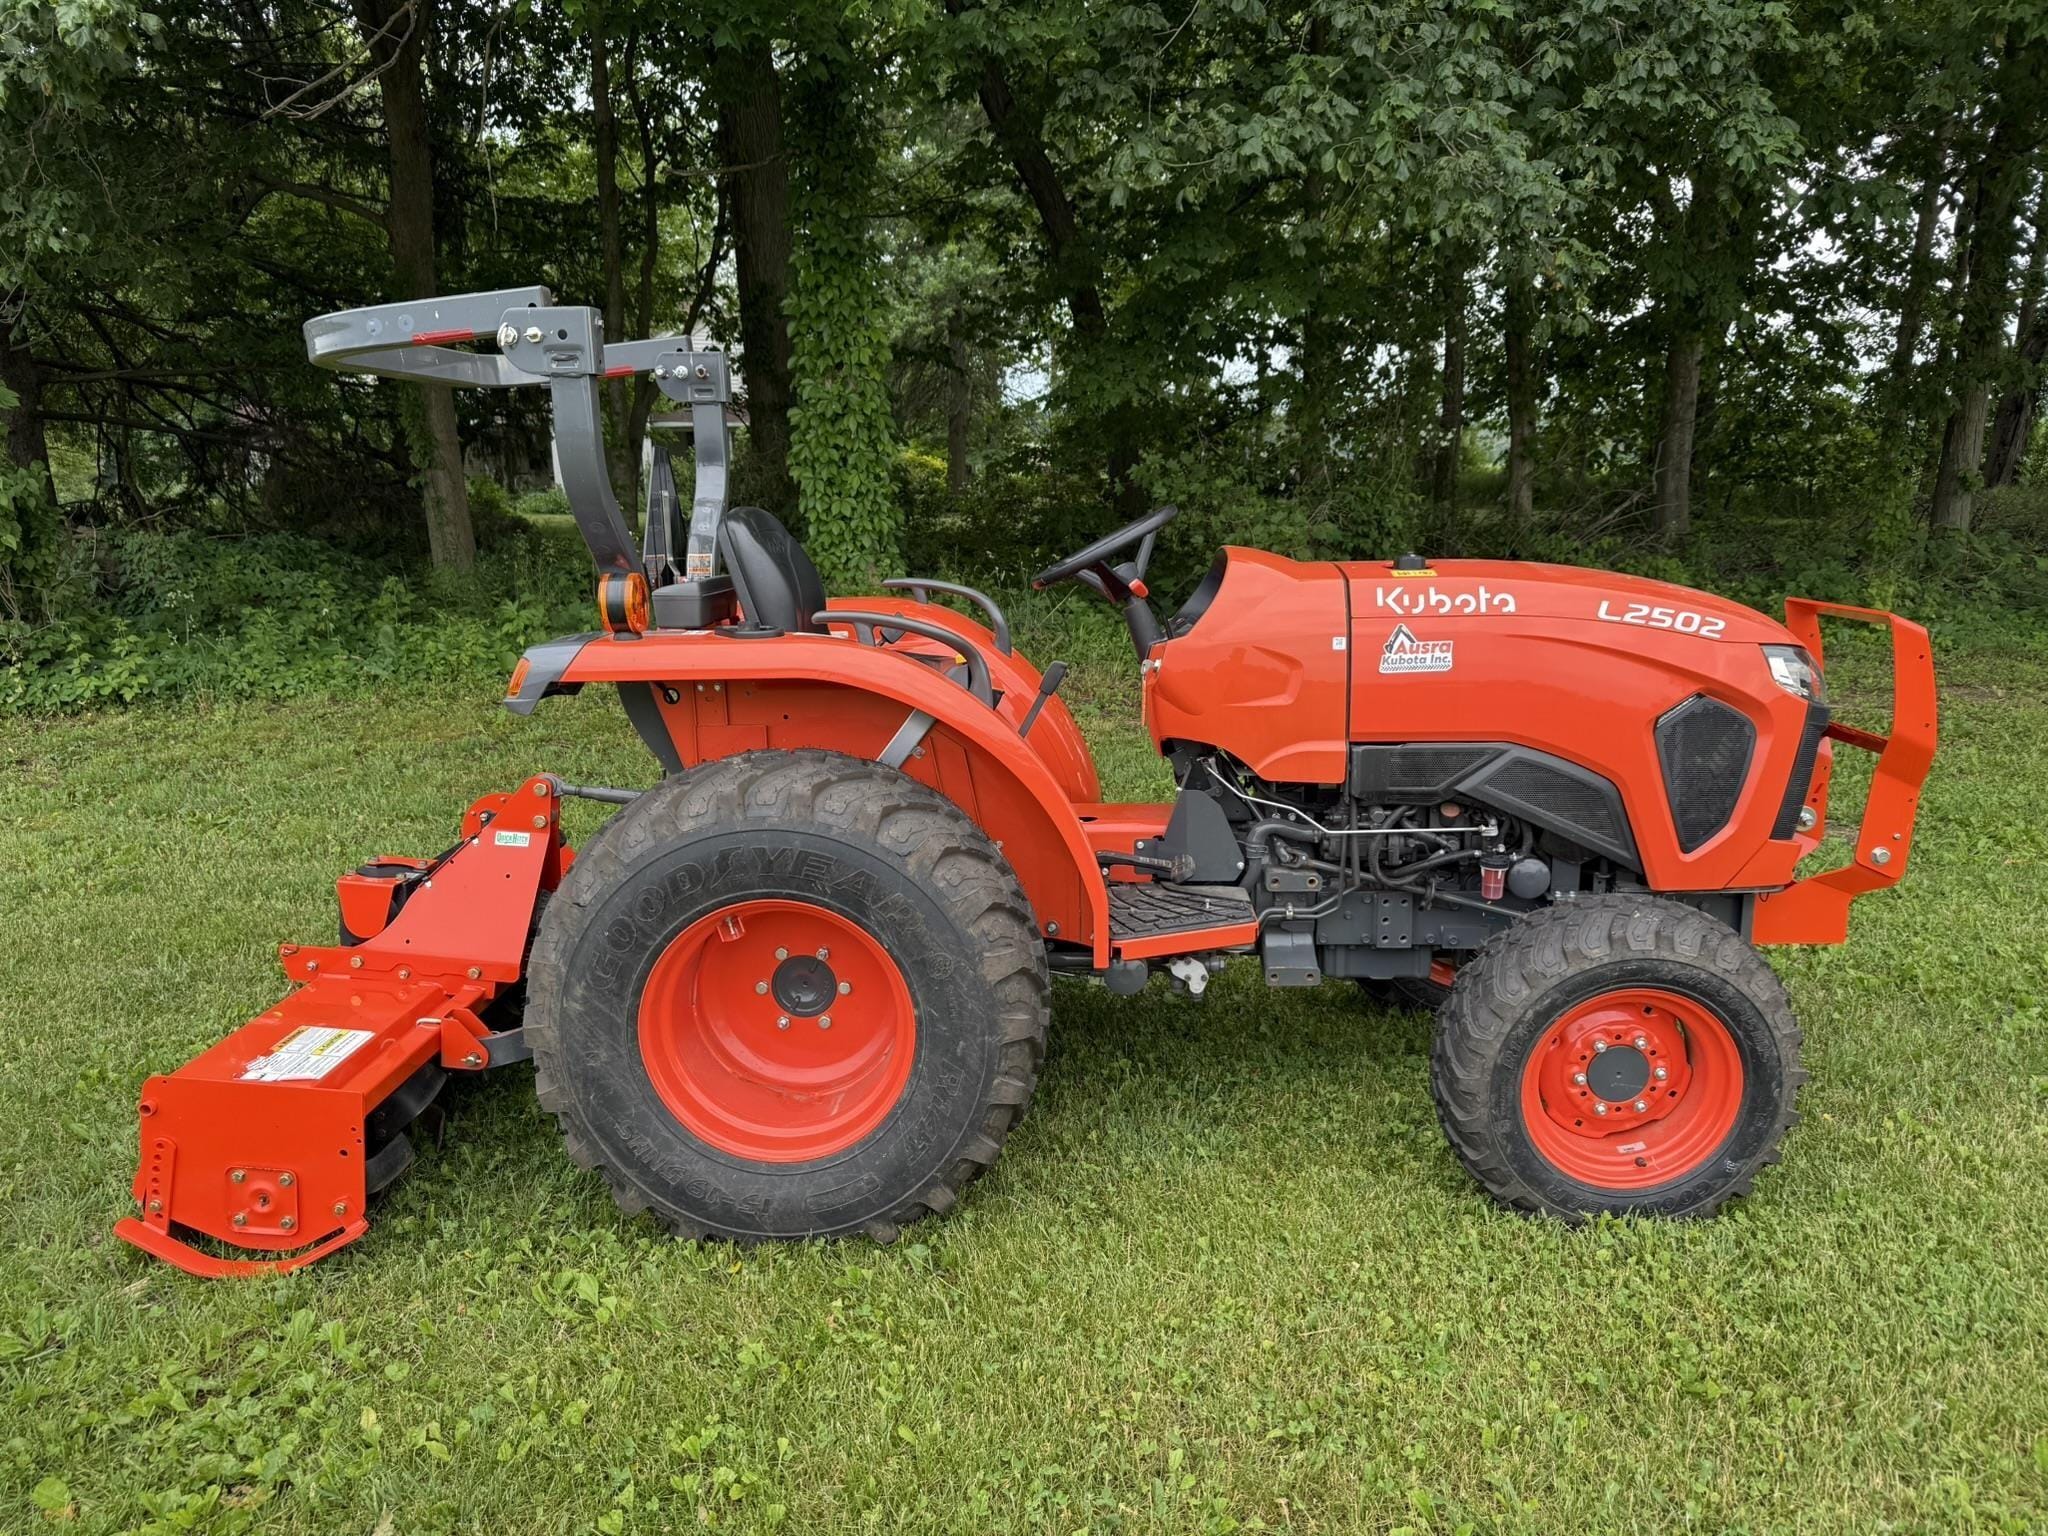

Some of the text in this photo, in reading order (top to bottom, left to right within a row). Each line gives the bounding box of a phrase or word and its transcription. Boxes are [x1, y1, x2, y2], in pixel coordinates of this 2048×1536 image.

[1376, 585, 1517, 615] Kubota
[1597, 599, 1726, 640] L2502
[1382, 653, 1452, 666] Kubota Inc.
[1394, 640, 1452, 656] Ausra
[586, 846, 925, 990] GOODYEAR
